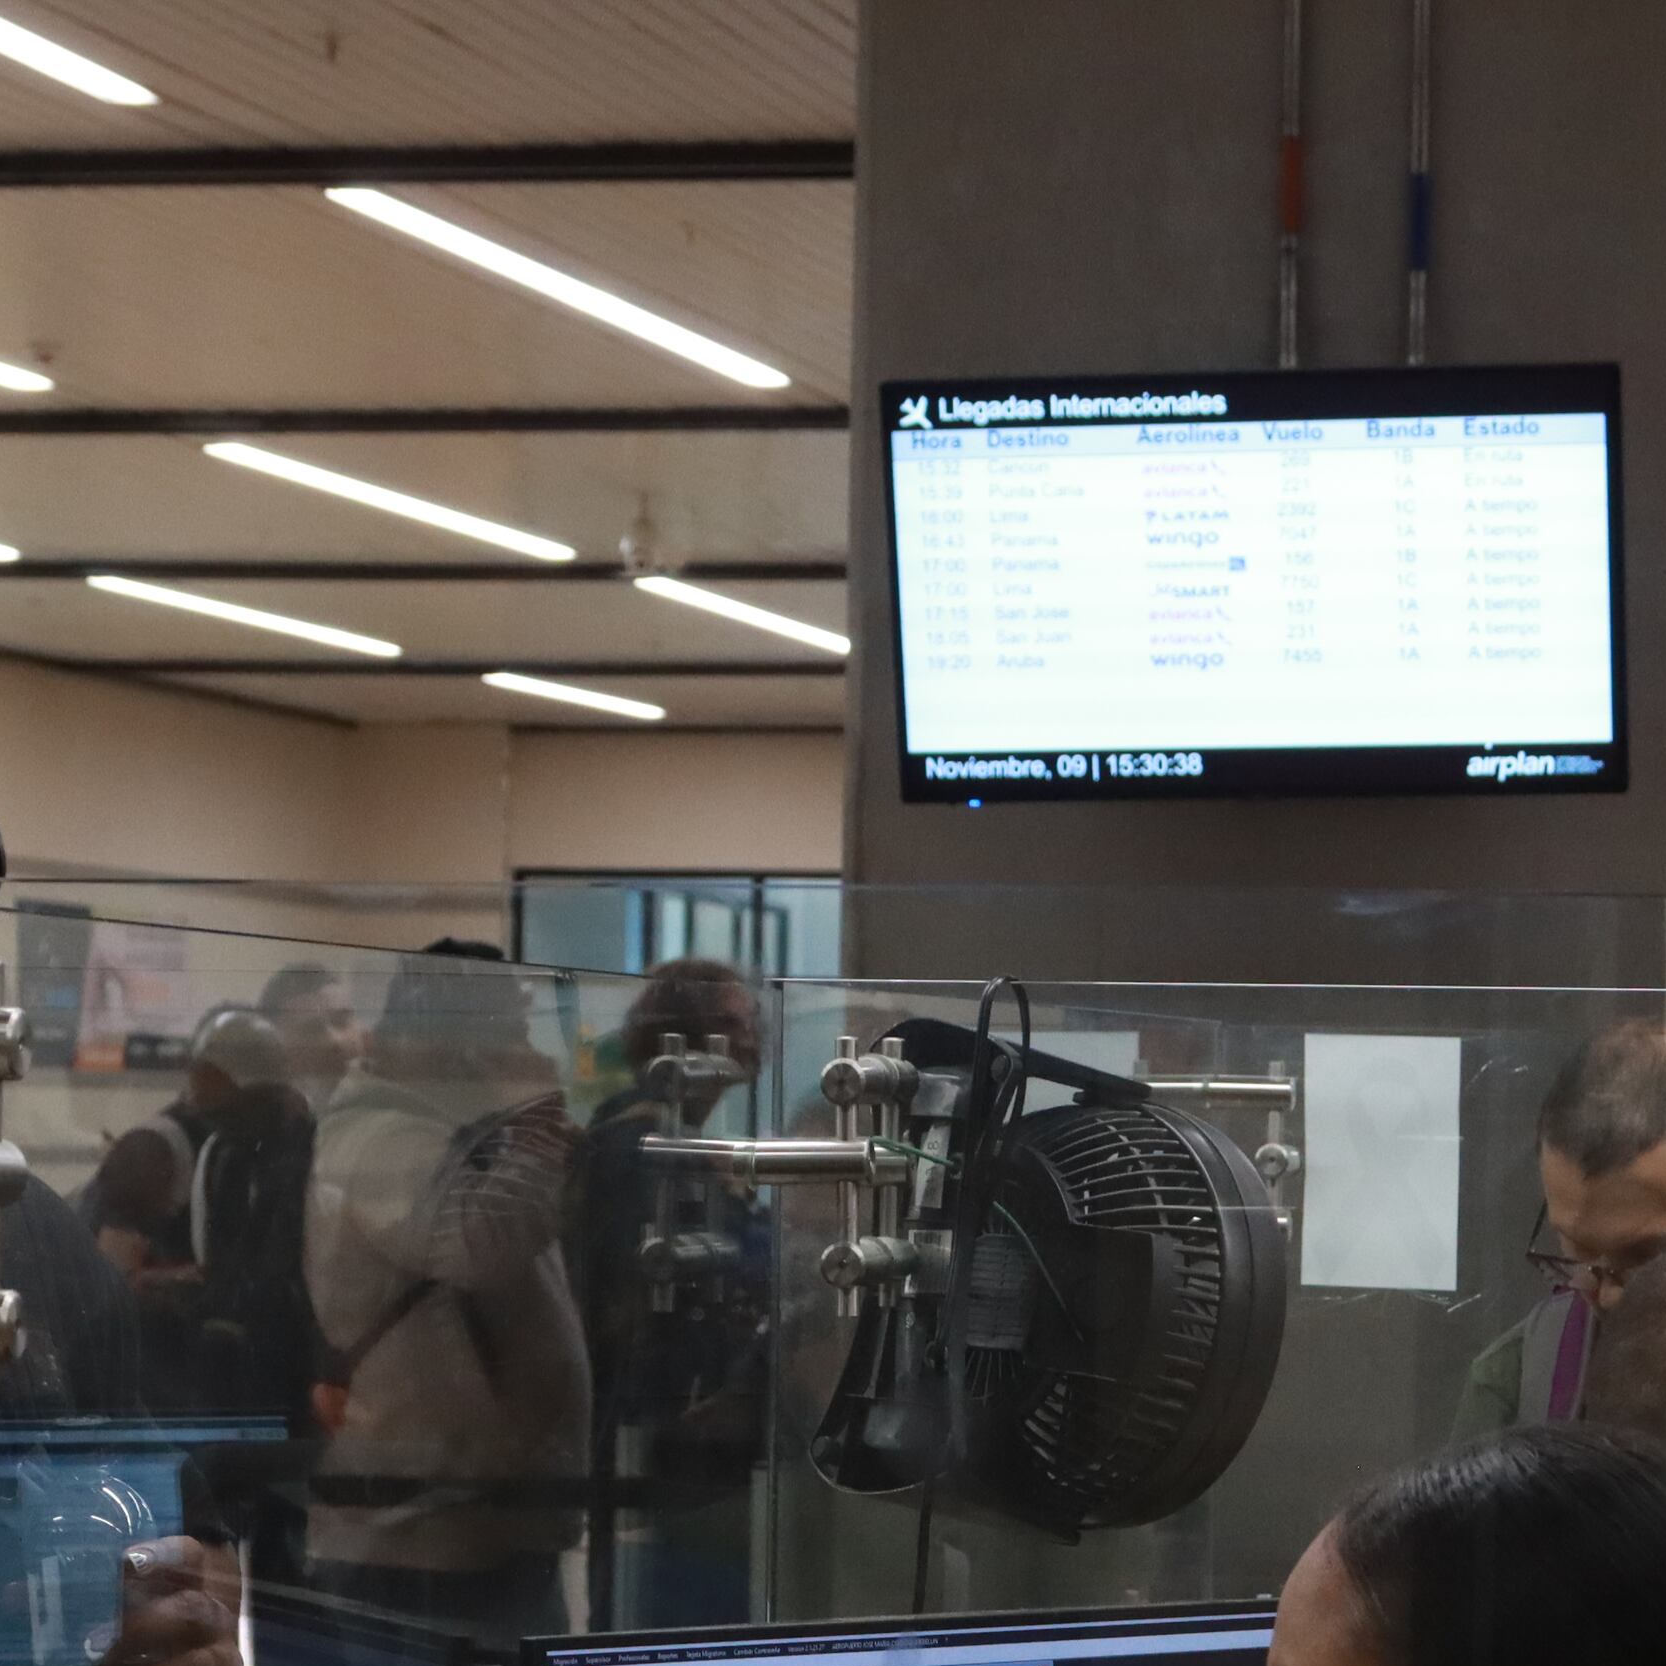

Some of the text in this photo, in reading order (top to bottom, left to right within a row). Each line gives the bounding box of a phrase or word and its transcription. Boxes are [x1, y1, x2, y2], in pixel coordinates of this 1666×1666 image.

[938, 390, 1228, 425] Llegadas Internacionales
[911, 431, 963, 450] Hora
[986, 428, 1070, 449] Destino
[1261, 420, 1324, 441] Vuelo
[1365, 419, 1436, 439] Banda
[1462, 415, 1540, 437] Estado
[1146, 530, 1220, 549] wingo
[1150, 652, 1225, 670] wingo
[925, 753, 1204, 782] Noviembre, 09 15:30:38
